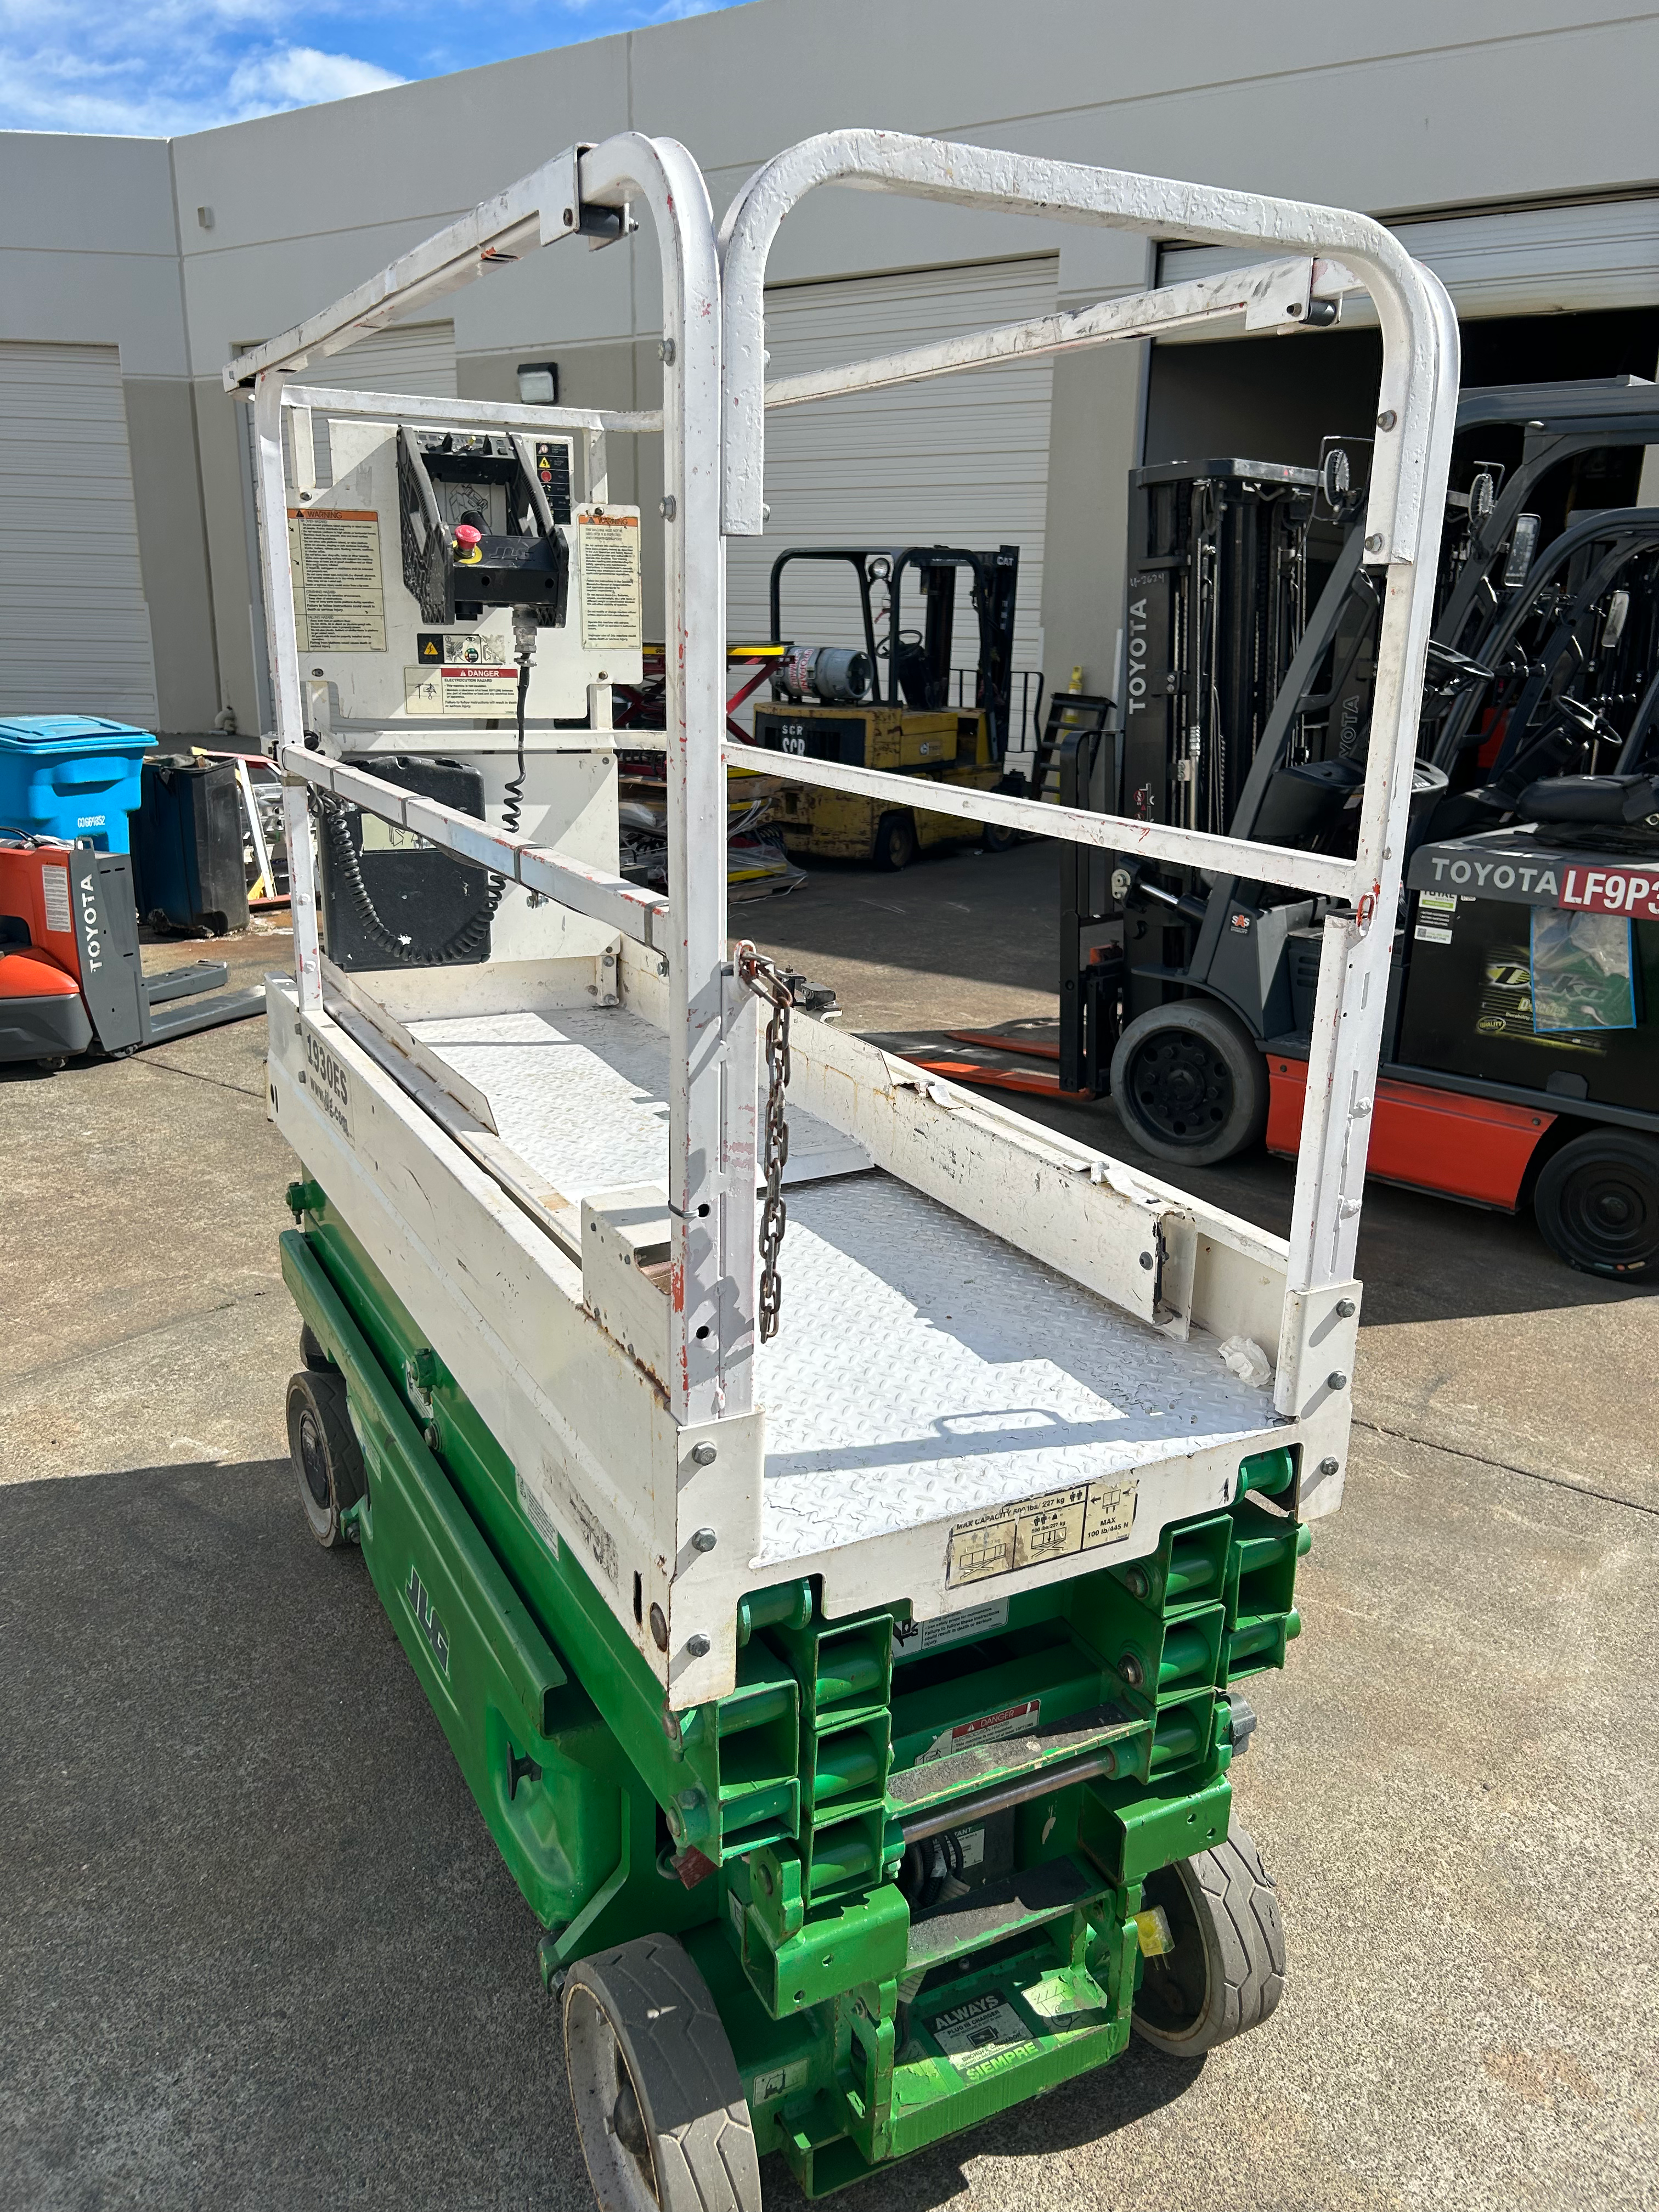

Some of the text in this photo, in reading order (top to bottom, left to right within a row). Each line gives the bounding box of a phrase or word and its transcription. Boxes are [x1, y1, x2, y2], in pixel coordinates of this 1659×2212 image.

[307, 511, 342, 519] WARNING
[996, 556, 1014, 566] CAT
[1128, 599, 1147, 714] TOYOTA
[782, 725, 803, 736] SCR
[1431, 857, 1559, 895] TOYOTA
[81, 874, 103, 973] TOYOTA
[1231, 915, 1250, 928] SAS
[307, 1034, 348, 1105] 1930ES
[310, 1076, 350, 1137] www.jlg.com
[956, 1519, 973, 1530] MAX
[974, 1508, 1012, 1525] CAPACITY
[1042, 1498, 1054, 1508] 227
[1056, 1497, 1065, 1505] kg
[1100, 1517, 1116, 1527] MAX
[1088, 1530, 1099, 1538] 100
[1101, 1523, 1122, 1534] lb/445
[405, 1564, 450, 1677] JLG
[947, 1622, 960, 1630] follow
[974, 1610, 1000, 1622] instructions
[949, 1617, 960, 1625] props
[957, 1623, 969, 1632] death
[976, 1617, 992, 1626] serious
[980, 1709, 1014, 1728] DANGER
[954, 1720, 1010, 1743] ELECTROCUTION HAZARD
[935, 1995, 999, 2030] ALWAYS
[947, 2025, 964, 2035] PLUG
[972, 2010, 1000, 2025] CHARGER
[966, 2041, 1039, 2081] SIEMPRE
